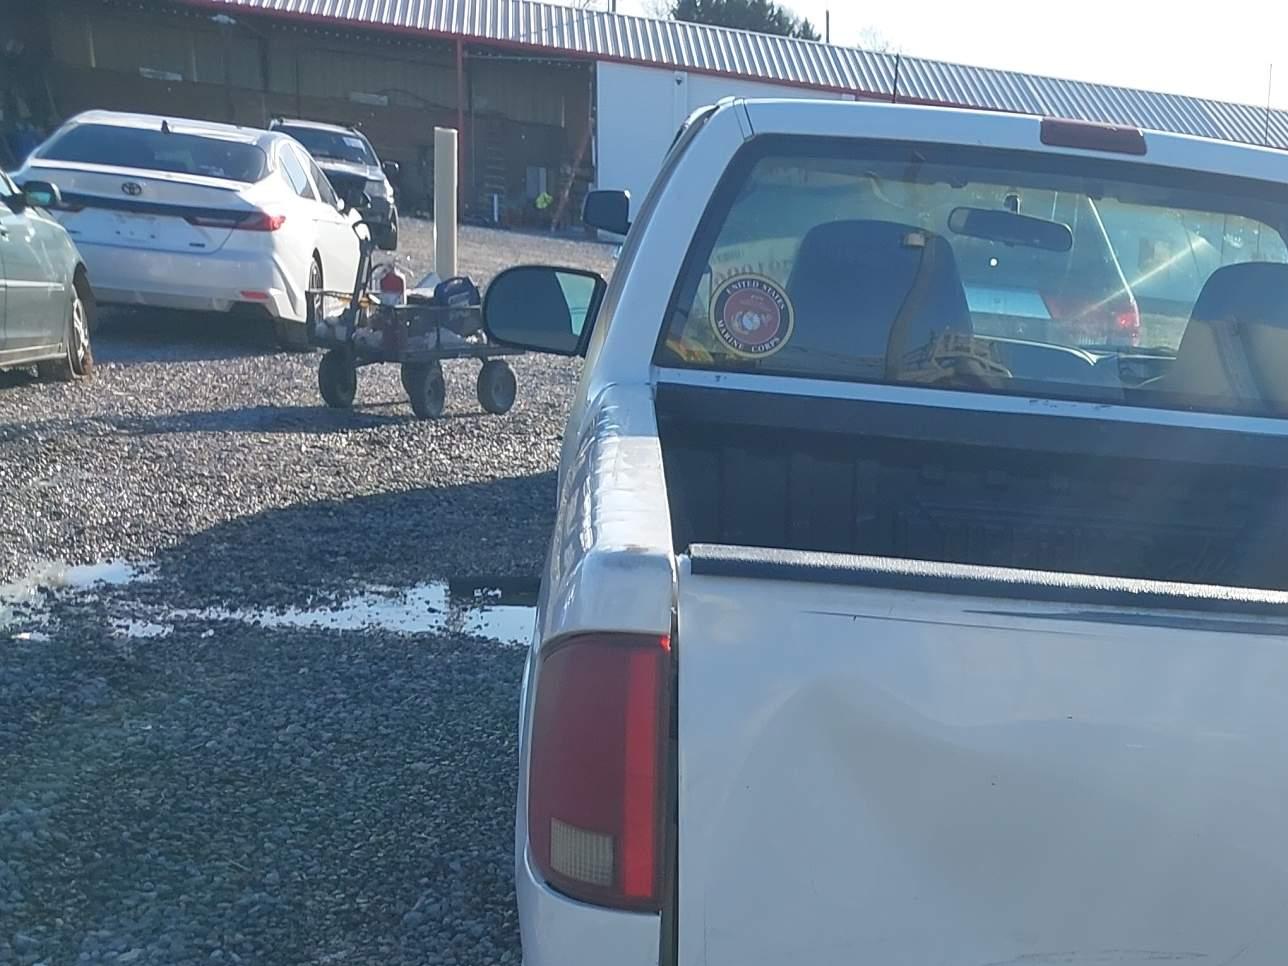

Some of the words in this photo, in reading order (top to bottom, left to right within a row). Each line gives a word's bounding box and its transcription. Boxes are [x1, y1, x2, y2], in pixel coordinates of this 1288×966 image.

[725, 279, 760, 295] UNITED
[762, 281, 786, 310] STATES
[717, 319, 743, 350] MARINE
[751, 336, 780, 353] CORPS
